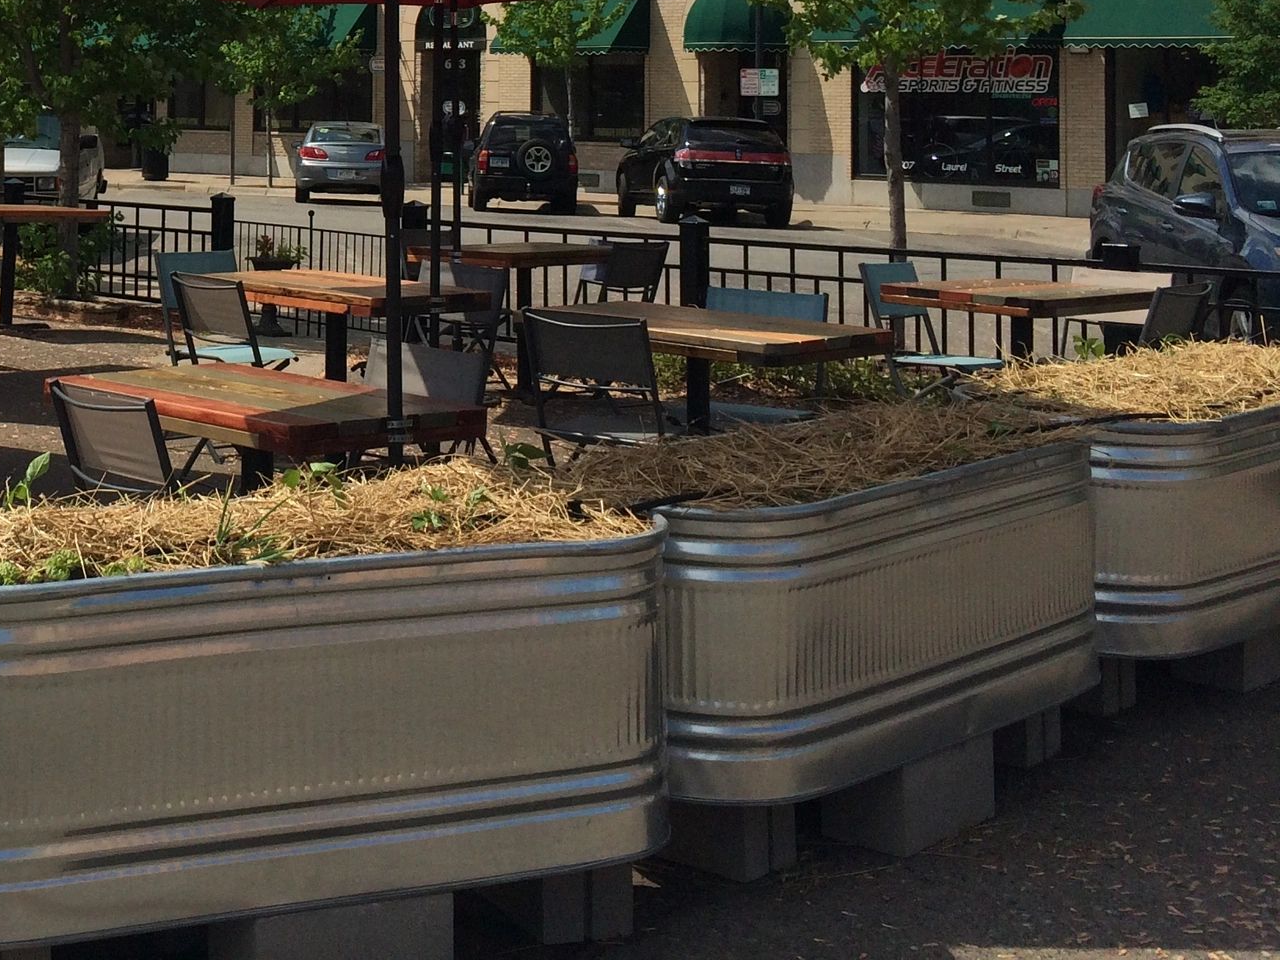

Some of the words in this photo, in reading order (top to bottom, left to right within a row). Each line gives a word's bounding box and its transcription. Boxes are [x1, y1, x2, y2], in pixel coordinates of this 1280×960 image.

[862, 48, 1053, 80] Aceleration
[898, 78, 960, 93] SPORTS
[962, 79, 977, 93] &
[979, 78, 1049, 94] FITNESS
[902, 161, 915, 169] 07
[942, 162, 968, 172] Laurel
[995, 163, 1022, 174] Street
